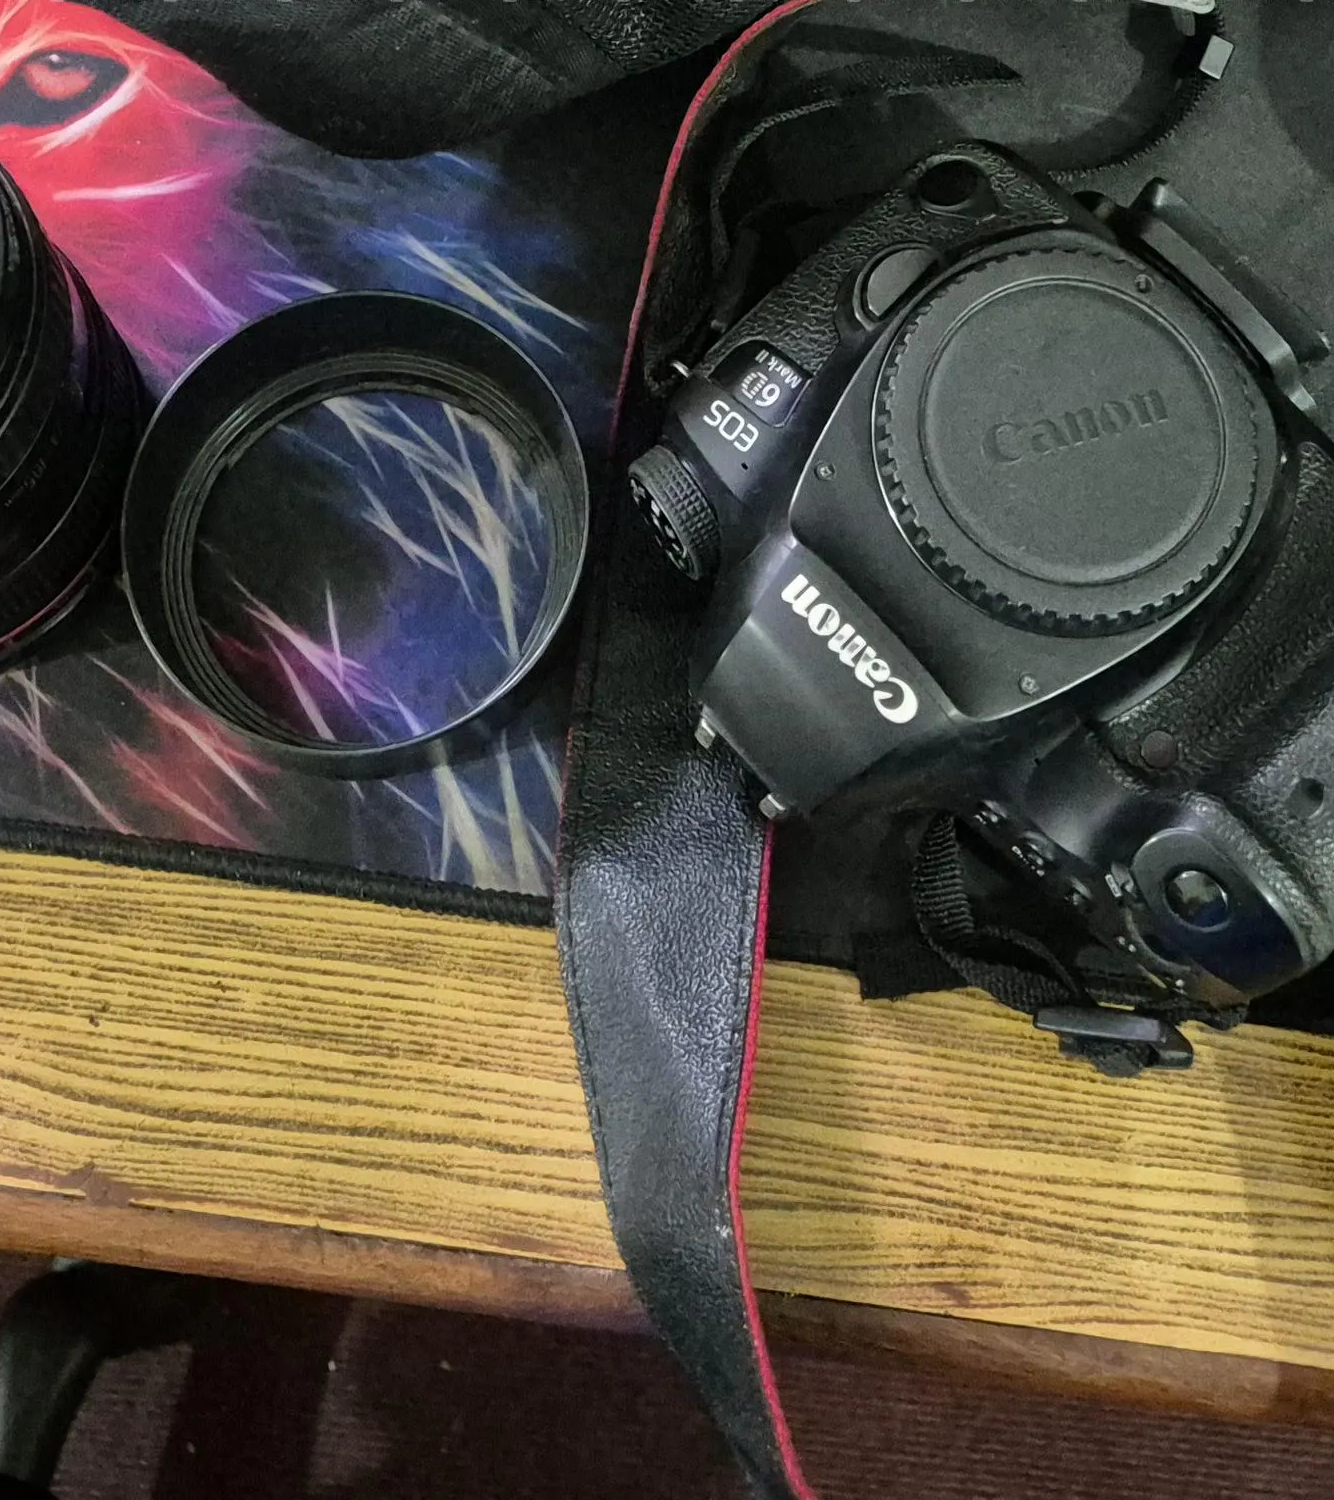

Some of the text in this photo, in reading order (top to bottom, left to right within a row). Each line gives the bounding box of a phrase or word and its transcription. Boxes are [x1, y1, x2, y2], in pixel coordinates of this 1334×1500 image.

[740, 371, 781, 407] 6D
[766, 355, 803, 389] Mark
[702, 399, 759, 453] EOS
[981, 386, 1170, 465] Canon
[779, 572, 920, 726] Canon
